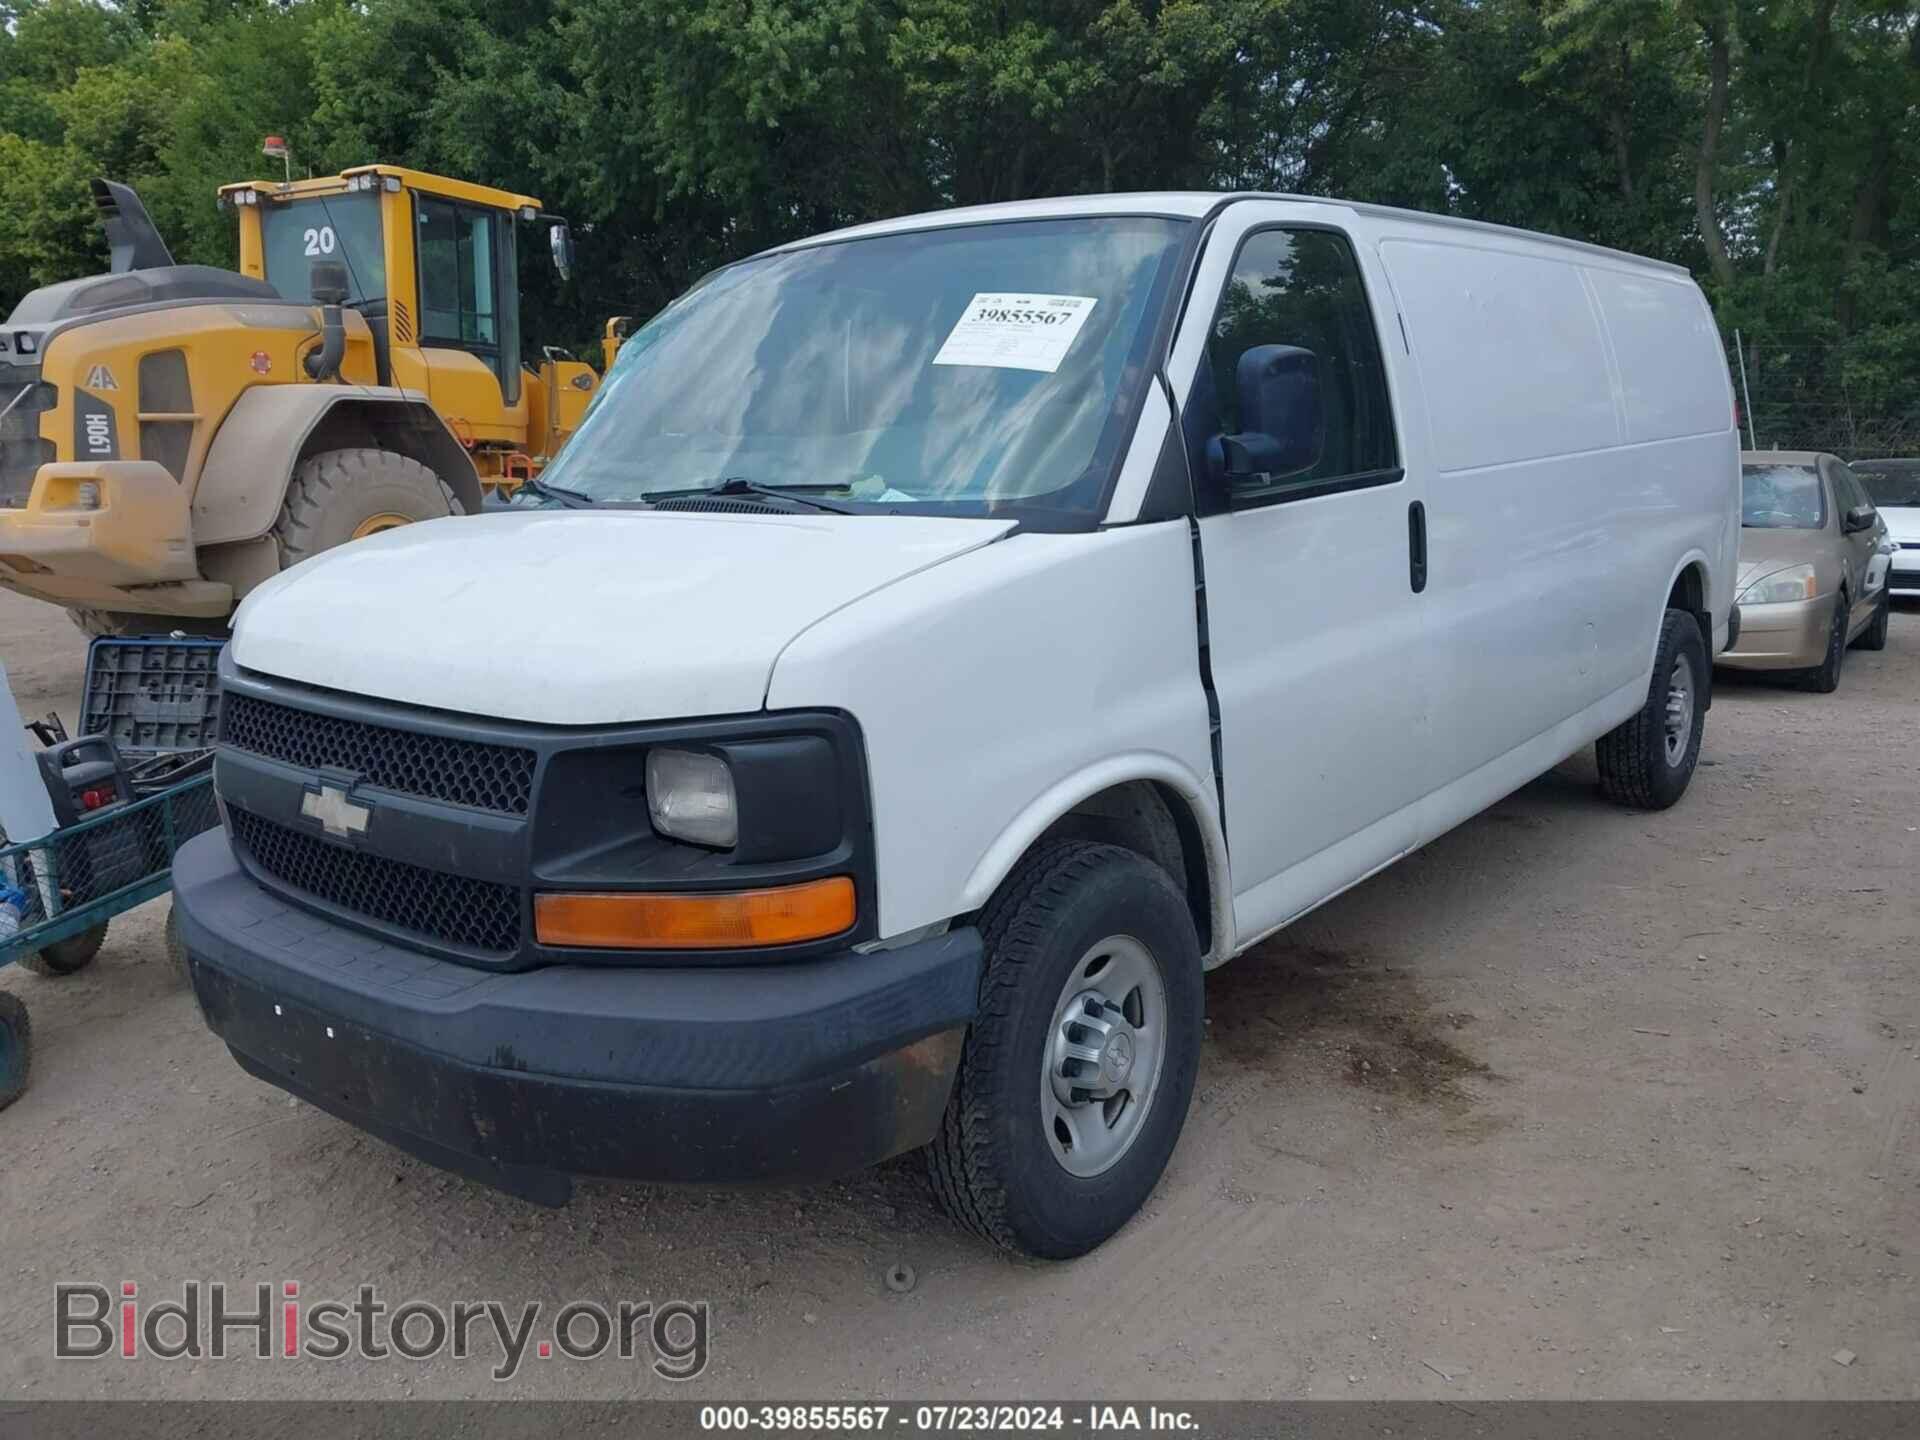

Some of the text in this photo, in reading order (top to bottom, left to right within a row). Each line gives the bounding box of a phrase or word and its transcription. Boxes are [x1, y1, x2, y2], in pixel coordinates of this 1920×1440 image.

[304, 226, 335, 256] 20
[972, 308, 1072, 326] 39855567
[85, 414, 112, 453] L90H
